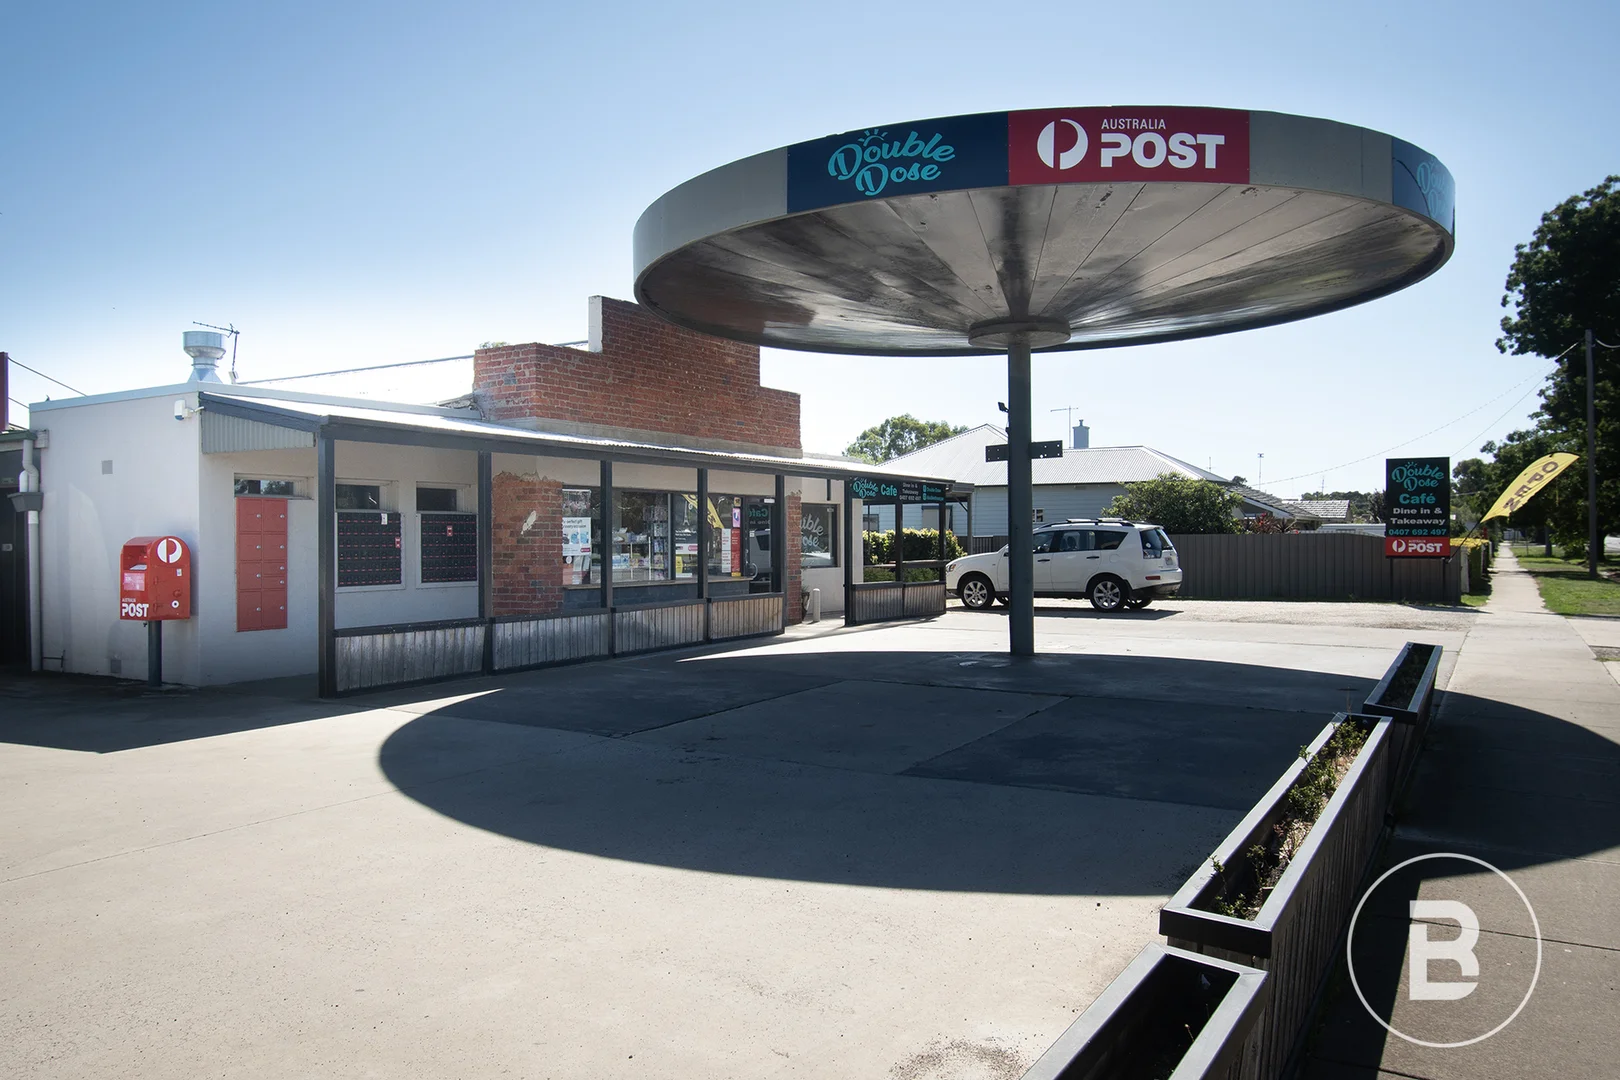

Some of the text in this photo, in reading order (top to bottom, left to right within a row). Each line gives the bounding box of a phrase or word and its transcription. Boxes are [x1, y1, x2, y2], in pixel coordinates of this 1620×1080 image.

[1101, 118, 1166, 130] AUSTRALIA
[827, 131, 956, 180] Double
[1100, 131, 1226, 170] POST
[855, 162, 942, 196] Dose
[1391, 464, 1444, 483] Double
[853, 478, 878, 493] Double
[1403, 476, 1439, 491] Dose
[1503, 461, 1559, 511] OPEN
[859, 488, 876, 499] Dose
[1399, 492, 1436, 504] Café
[1393, 507, 1442, 515] Dine in &
[1390, 517, 1446, 526] Takeaway
[1388, 528, 1447, 536] 0407 692 497
[1408, 542, 1443, 553] POST
[121, 602, 149, 617] POST
